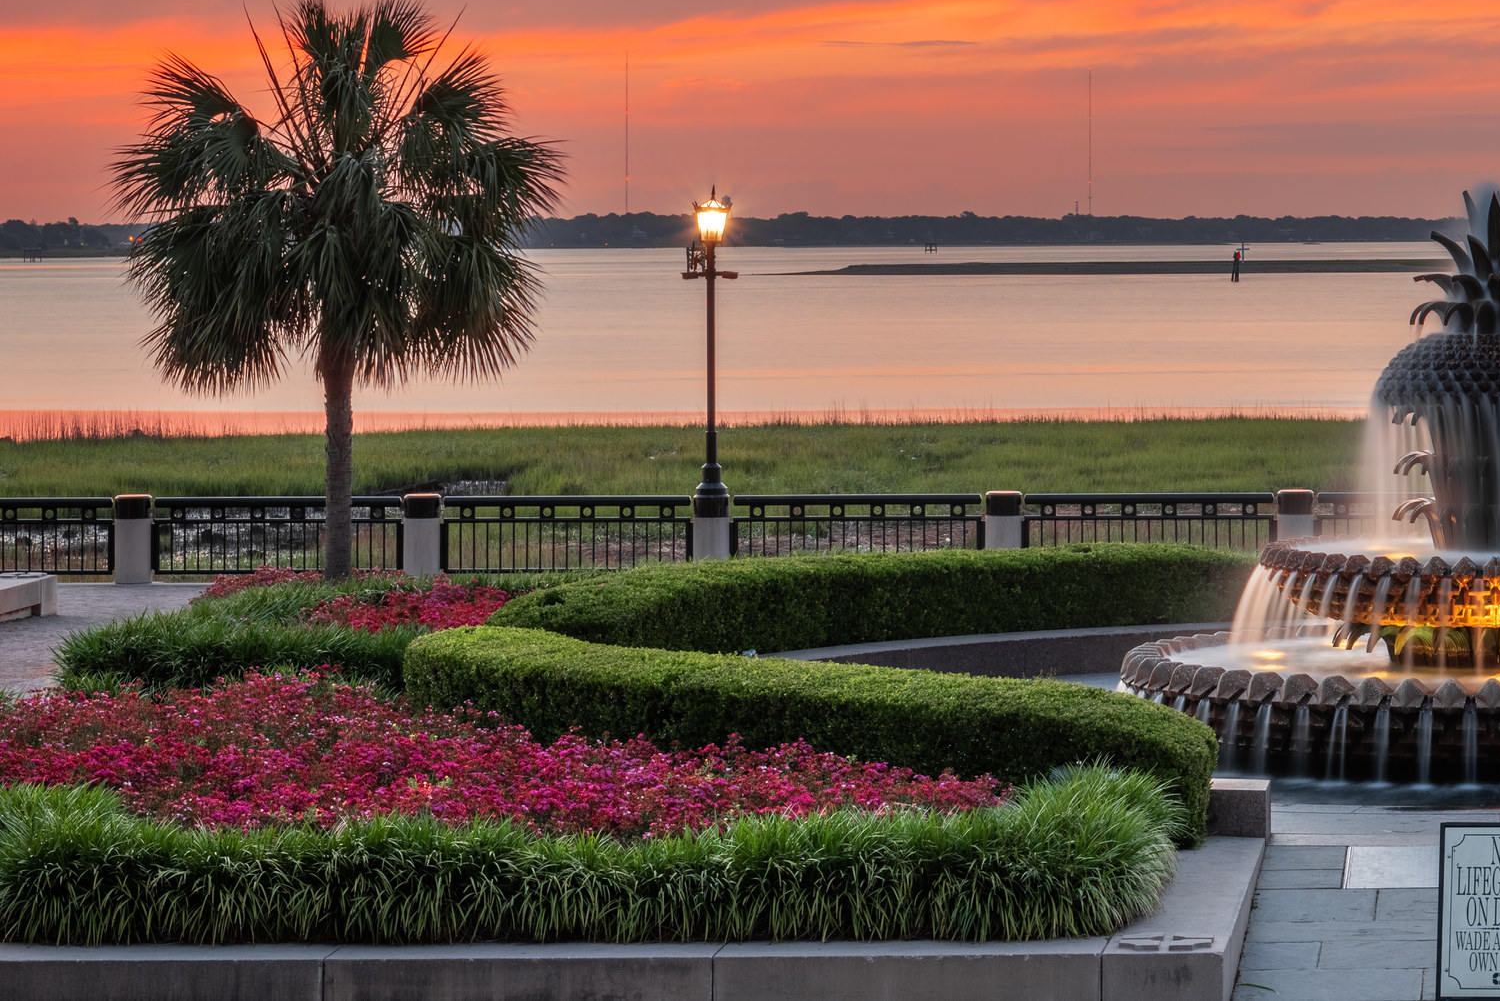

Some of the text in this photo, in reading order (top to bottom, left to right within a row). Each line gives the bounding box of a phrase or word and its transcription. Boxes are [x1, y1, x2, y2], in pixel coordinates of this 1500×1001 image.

[1466, 897, 1489, 927] ON
[1455, 931, 1490, 951] WADE
[1469, 952, 1498, 972] OWN
